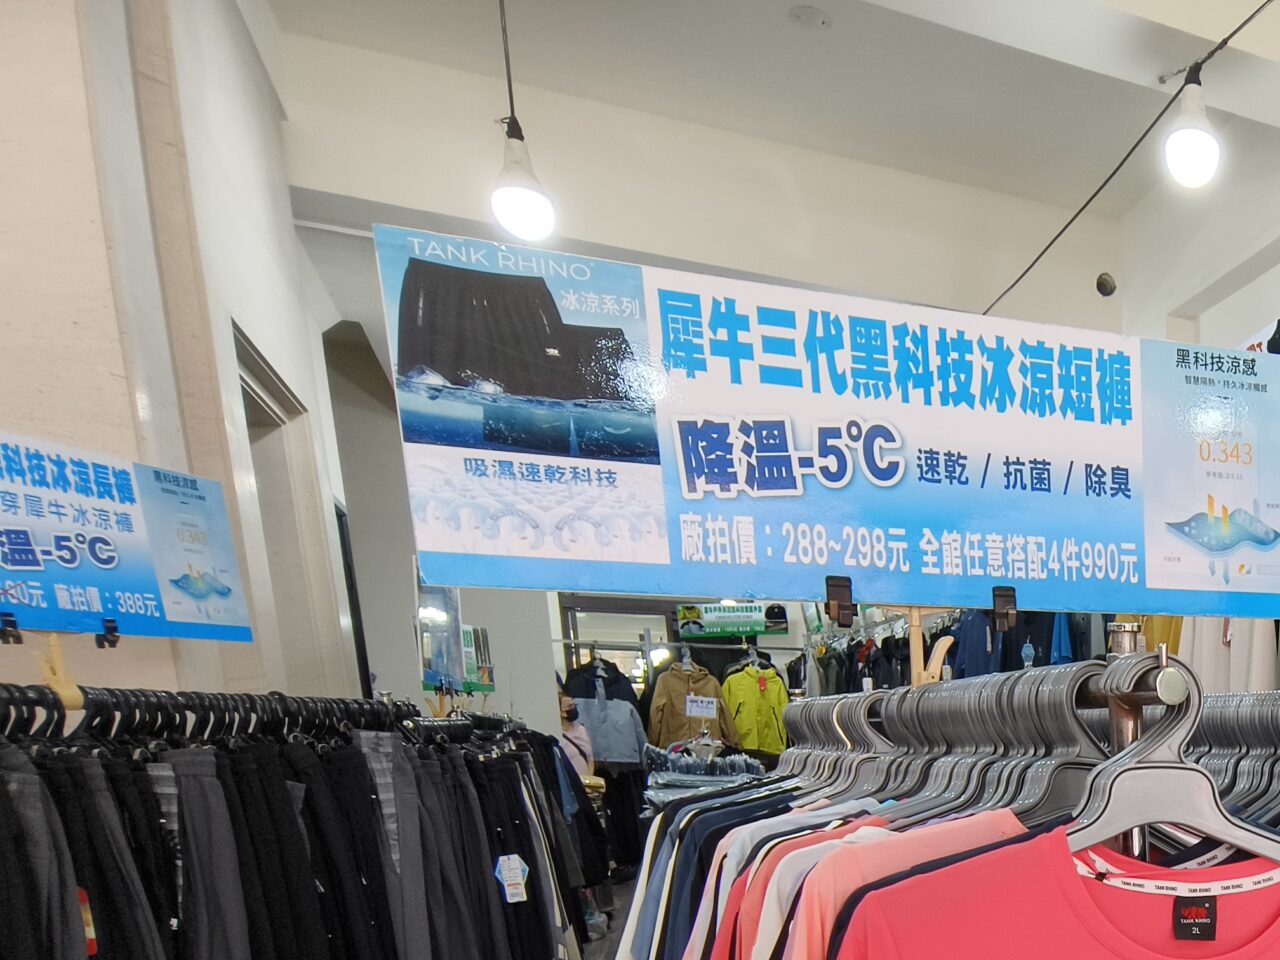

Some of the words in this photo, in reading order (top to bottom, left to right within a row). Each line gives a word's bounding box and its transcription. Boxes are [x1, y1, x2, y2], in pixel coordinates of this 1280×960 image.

[407, 236, 490, 267] TANK
[498, 251, 592, 281] RHINO
[560, 289, 641, 320] 冰涼系列
[657, 287, 1133, 426] 犀牛三代黑科技冰涼短褲
[1176, 347, 1258, 377] 黑科技涼感
[1199, 438, 1254, 466] 0.343
[0, 442, 137, 506] 科技冰涼長褲
[463, 456, 619, 489] 吸濕速乾科技
[917, 447, 969, 486] 速乾
[1003, 455, 1052, 494] 抗菌
[1085, 462, 1132, 499] 除臭
[920, 527, 1140, 585] 全館任意搭配4件990元
[1191, 926, 1201, 935] 2L
